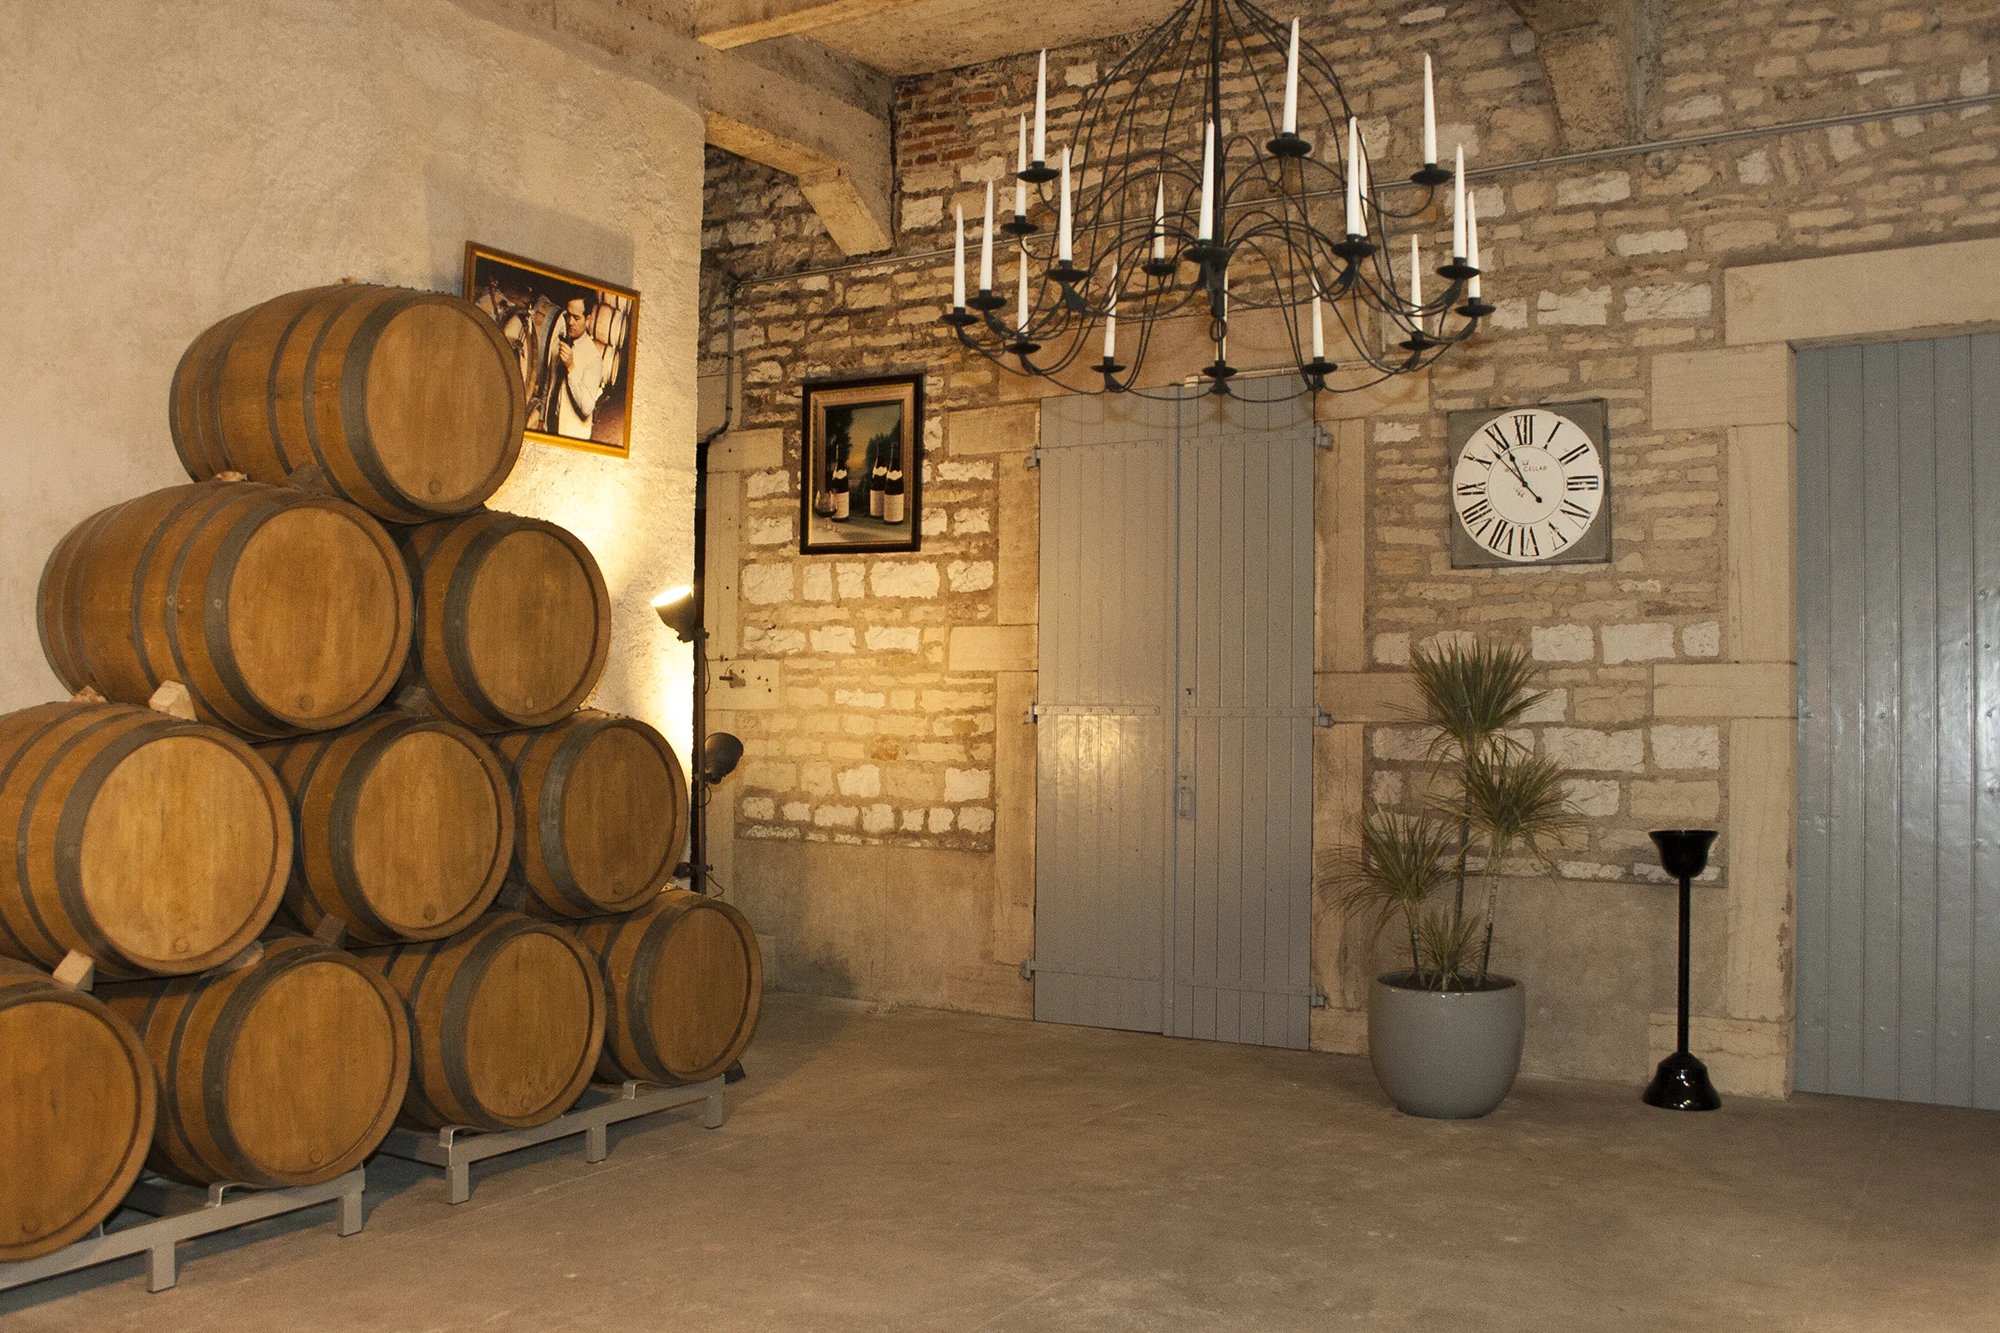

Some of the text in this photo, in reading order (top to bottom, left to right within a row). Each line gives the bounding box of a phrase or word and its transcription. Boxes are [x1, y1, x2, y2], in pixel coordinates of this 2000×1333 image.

[1484, 421, 1510, 453] XI
[1512, 414, 1536, 446] XII
[1543, 421, 1563, 450] I
[1463, 448, 1493, 471] X
[1559, 443, 1590, 466] II
[1457, 481, 1486, 496] IX
[1567, 475, 1598, 491] III
[1462, 498, 1493, 538] VIII
[1560, 499, 1591, 530] IV
[1488, 519, 1514, 555] VII
[1520, 526, 1539, 556] VI
[1548, 520, 1568, 551] V
